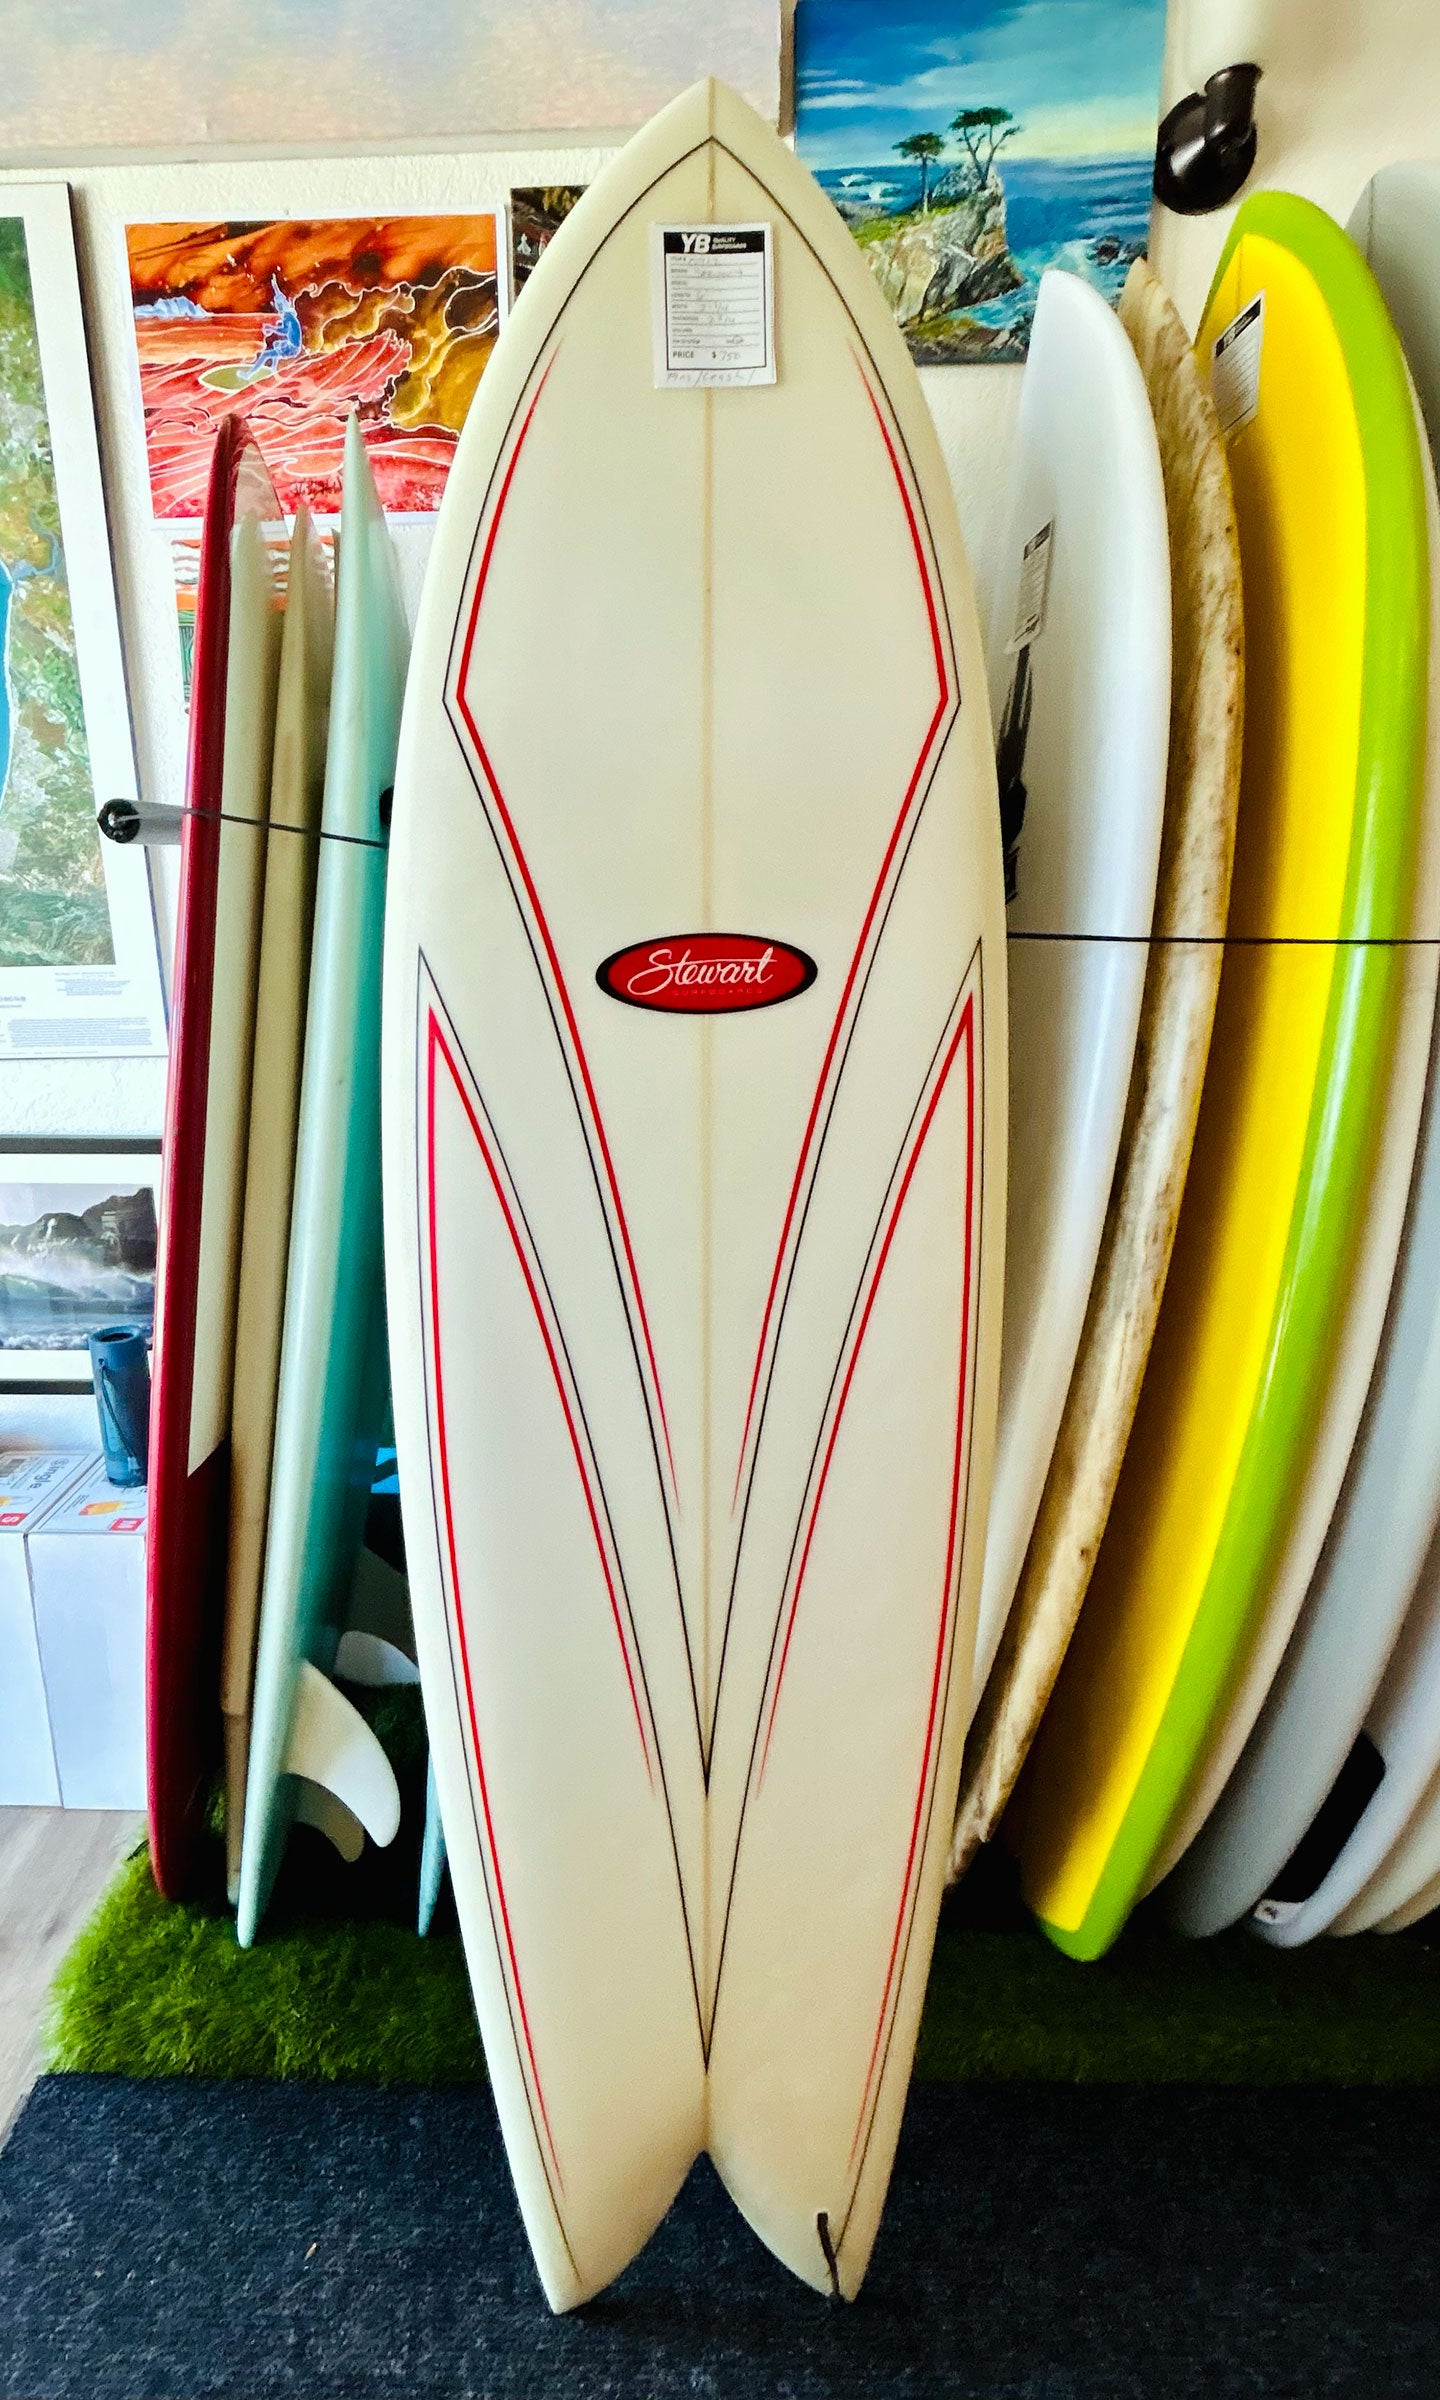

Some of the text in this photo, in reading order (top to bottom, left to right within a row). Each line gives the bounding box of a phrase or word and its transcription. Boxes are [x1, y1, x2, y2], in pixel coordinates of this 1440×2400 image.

[681, 233, 711, 254] YB
[672, 350, 695, 359] PRICE
[627, 946, 777, 996] Stewart
